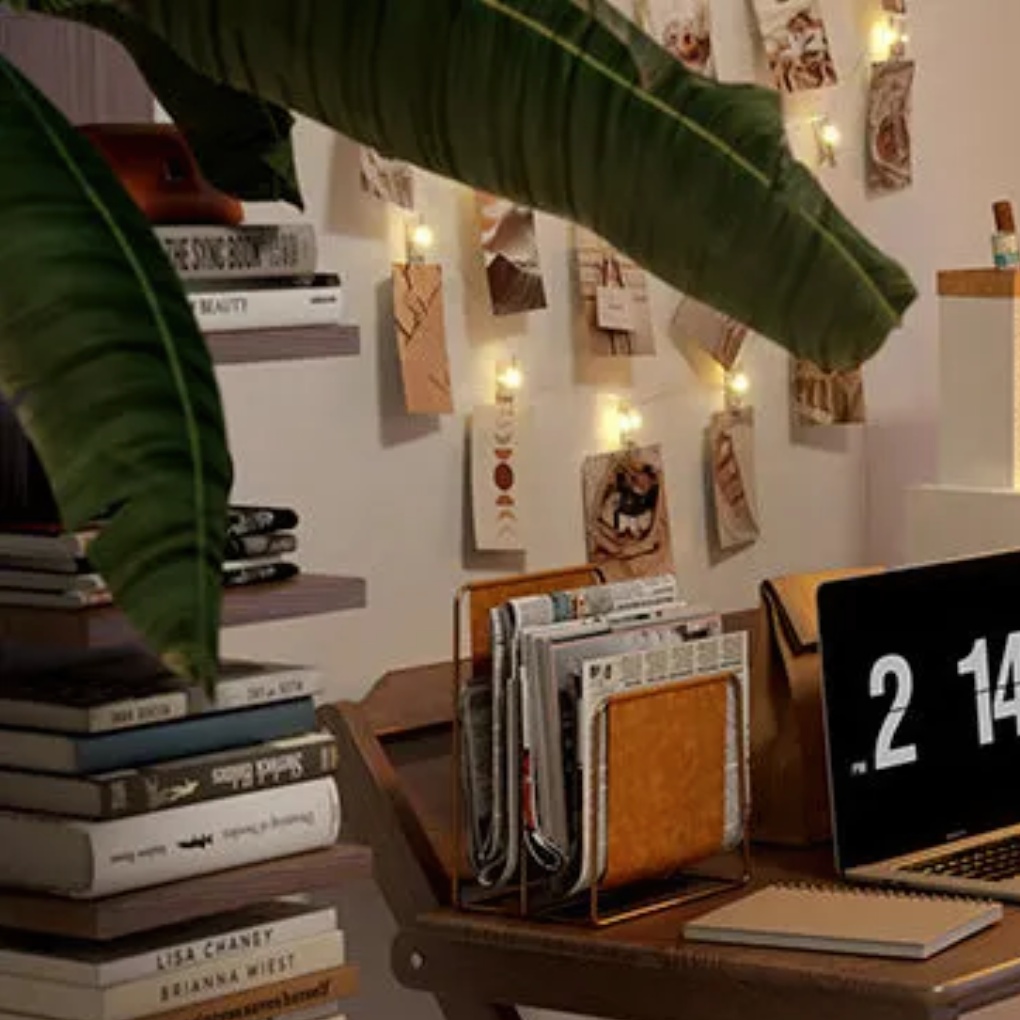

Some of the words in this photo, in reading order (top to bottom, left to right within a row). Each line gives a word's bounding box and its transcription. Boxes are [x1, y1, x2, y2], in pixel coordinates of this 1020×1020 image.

[869, 653, 917, 770] 2
[156, 949, 195, 971] LISA
[204, 928, 275, 959] CHANEY
[161, 969, 240, 1002] BRIANNA
[247, 954, 296, 977] WIEST
